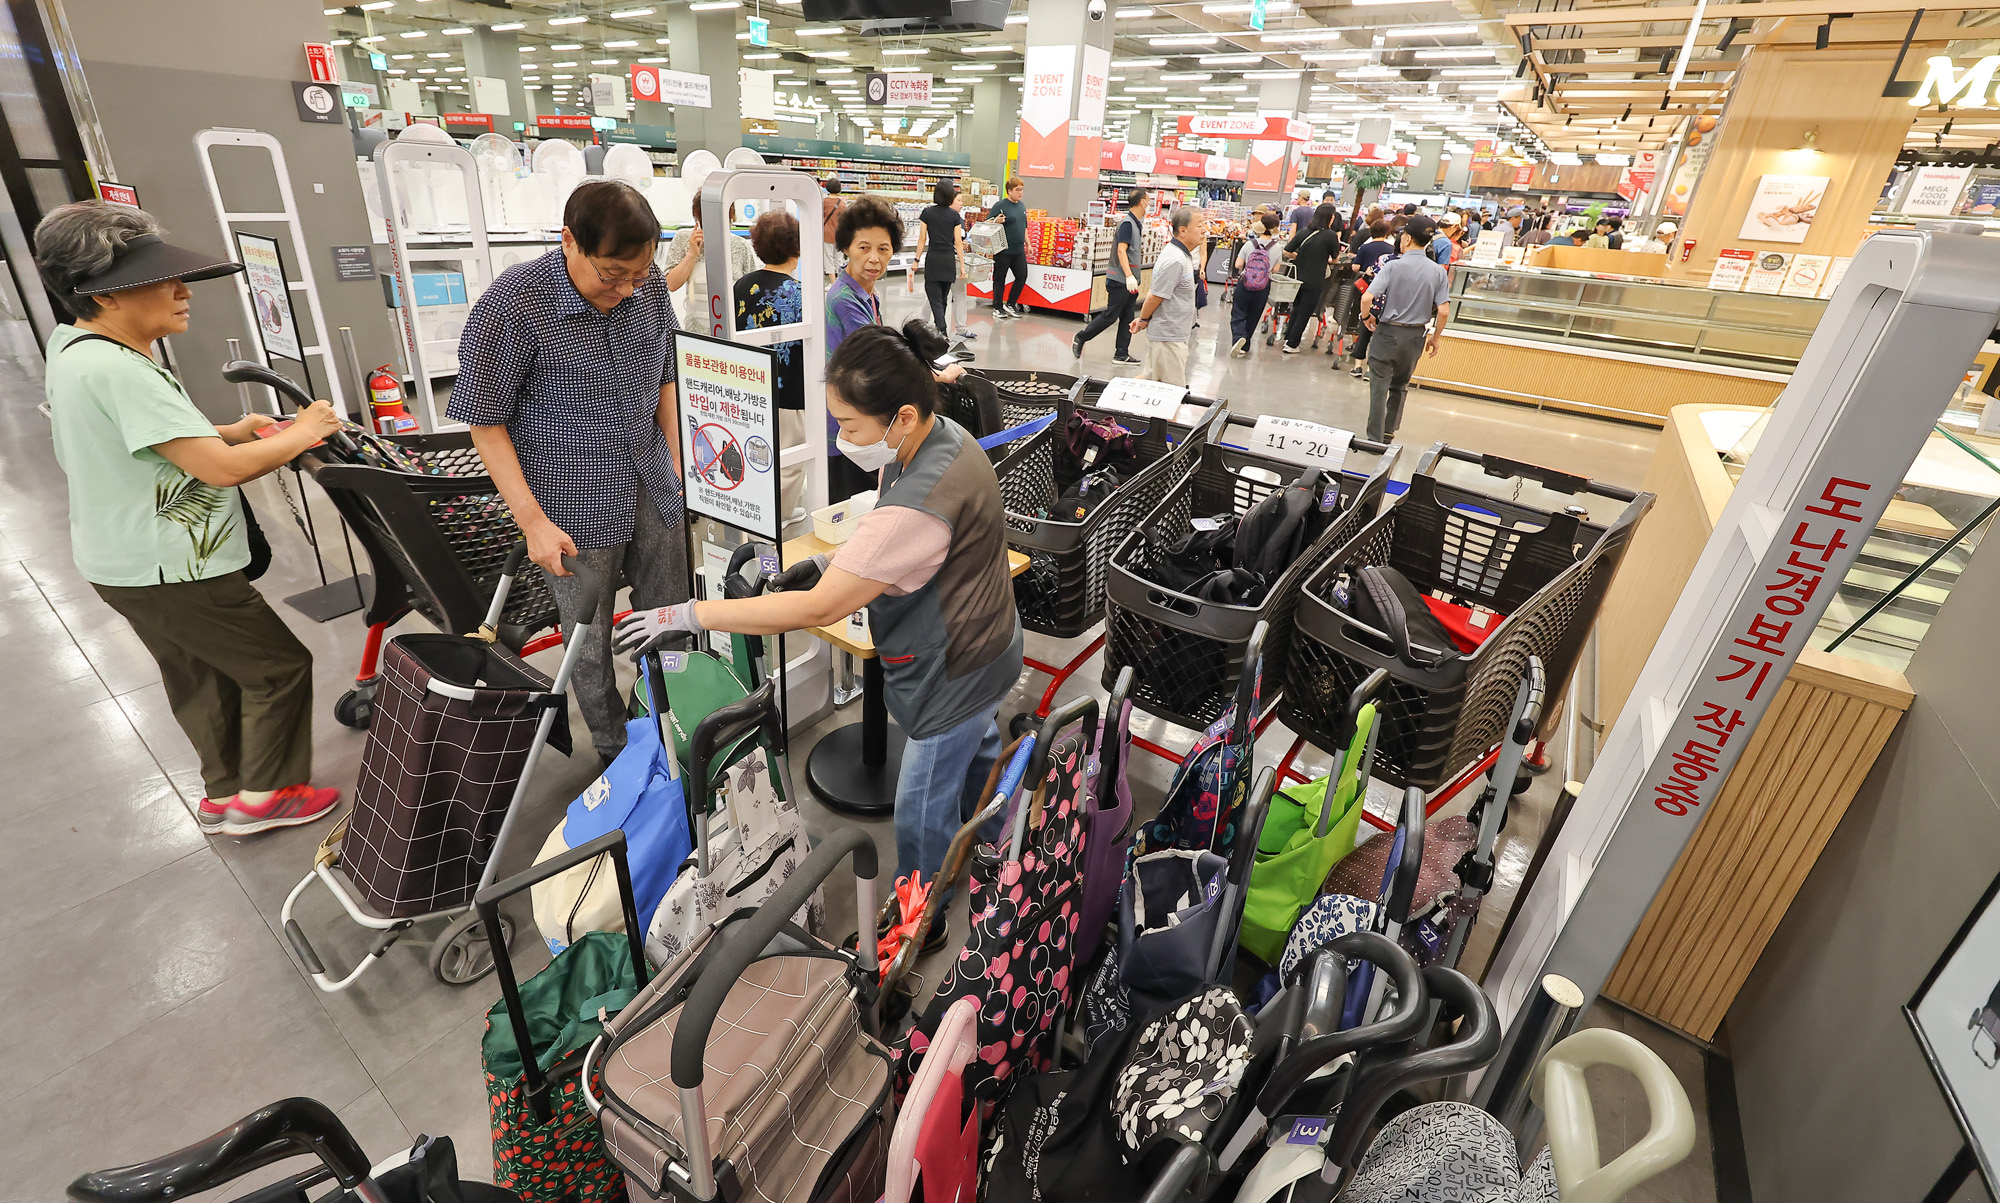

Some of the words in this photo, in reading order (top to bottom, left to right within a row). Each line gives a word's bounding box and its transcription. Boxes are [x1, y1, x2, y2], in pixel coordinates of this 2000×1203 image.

[1033, 74, 1064, 83] EVENT
[1086, 74, 1103, 88] EVENT
[890, 80, 909, 89] CCTV
[910, 80, 928, 91] 녹화중
[1032, 86, 1062, 96] ZONE
[1085, 86, 1101, 99] ZONE
[352, 96, 366, 105] 02
[1200, 121, 1228, 129] EVENT
[1229, 121, 1255, 130] ZONE
[1333, 145, 1353, 153] ZONE
[1126, 154, 1140, 162] EVENT
[1923, 185, 1948, 193] MEGA
[1043, 273, 1066, 283] EVENT
[1043, 282, 1065, 291] ZONE
[685, 353, 727, 375] 물품보관함
[729, 364, 765, 384] 이용안내
[689, 393, 717, 413] 반입이
[719, 401, 765, 426] 제한됩니다
[1266, 434, 1285, 450] 11
[1306, 441, 1329, 458] 20
[1324, 491, 1335, 503] 26
[763, 559, 777, 572] 35
[1336, 588, 1348, 600] 30
[1716, 477, 1872, 702] 도난경보기
[663, 655, 676, 668] 31
[1213, 720, 1226, 732] 37
[1654, 701, 1747, 817] 작동중
[1209, 876, 1219, 898] 29
[1419, 923, 1438, 944] 27
[1299, 1124, 1319, 1137] 3
